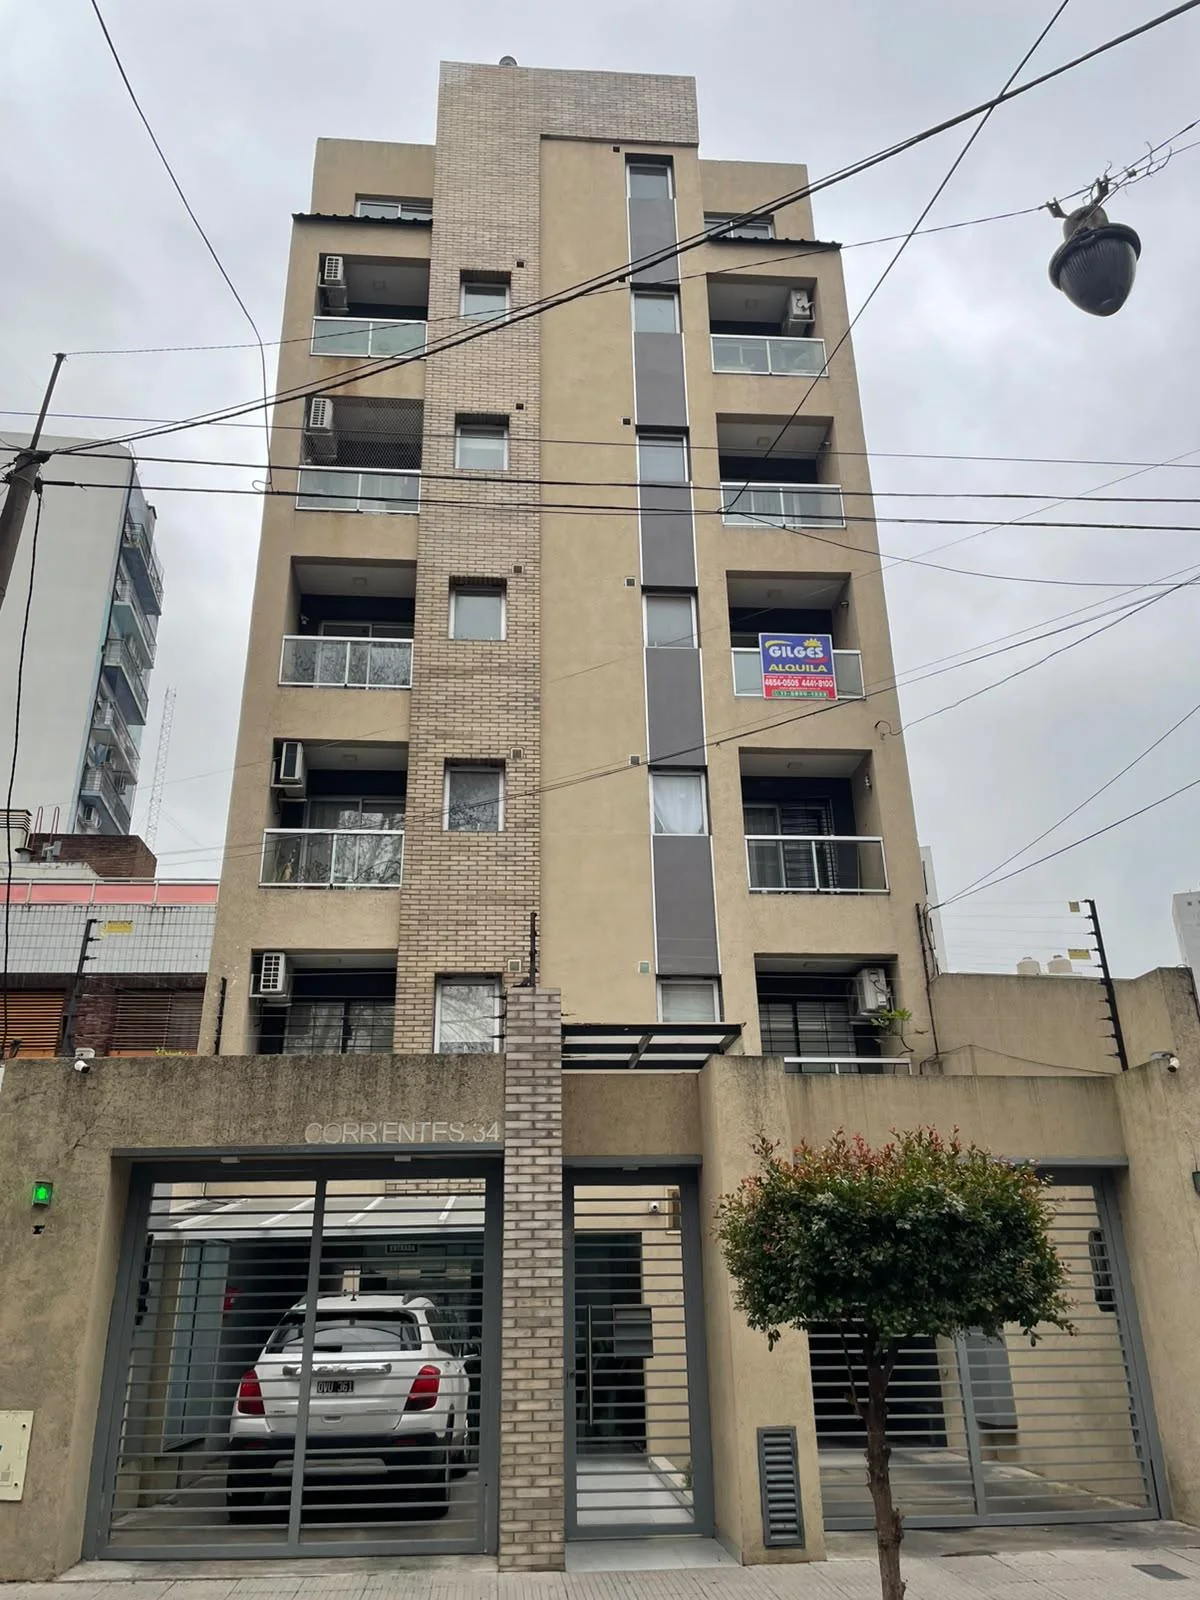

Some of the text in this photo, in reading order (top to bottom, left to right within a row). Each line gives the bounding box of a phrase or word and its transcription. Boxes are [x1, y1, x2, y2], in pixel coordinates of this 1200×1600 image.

[769, 646, 824, 658] GILGES
[768, 663, 828, 673] ALQUILA
[801, 679, 834, 688] 4441-8100
[304, 1121, 500, 1144] CORRIENTES 34
